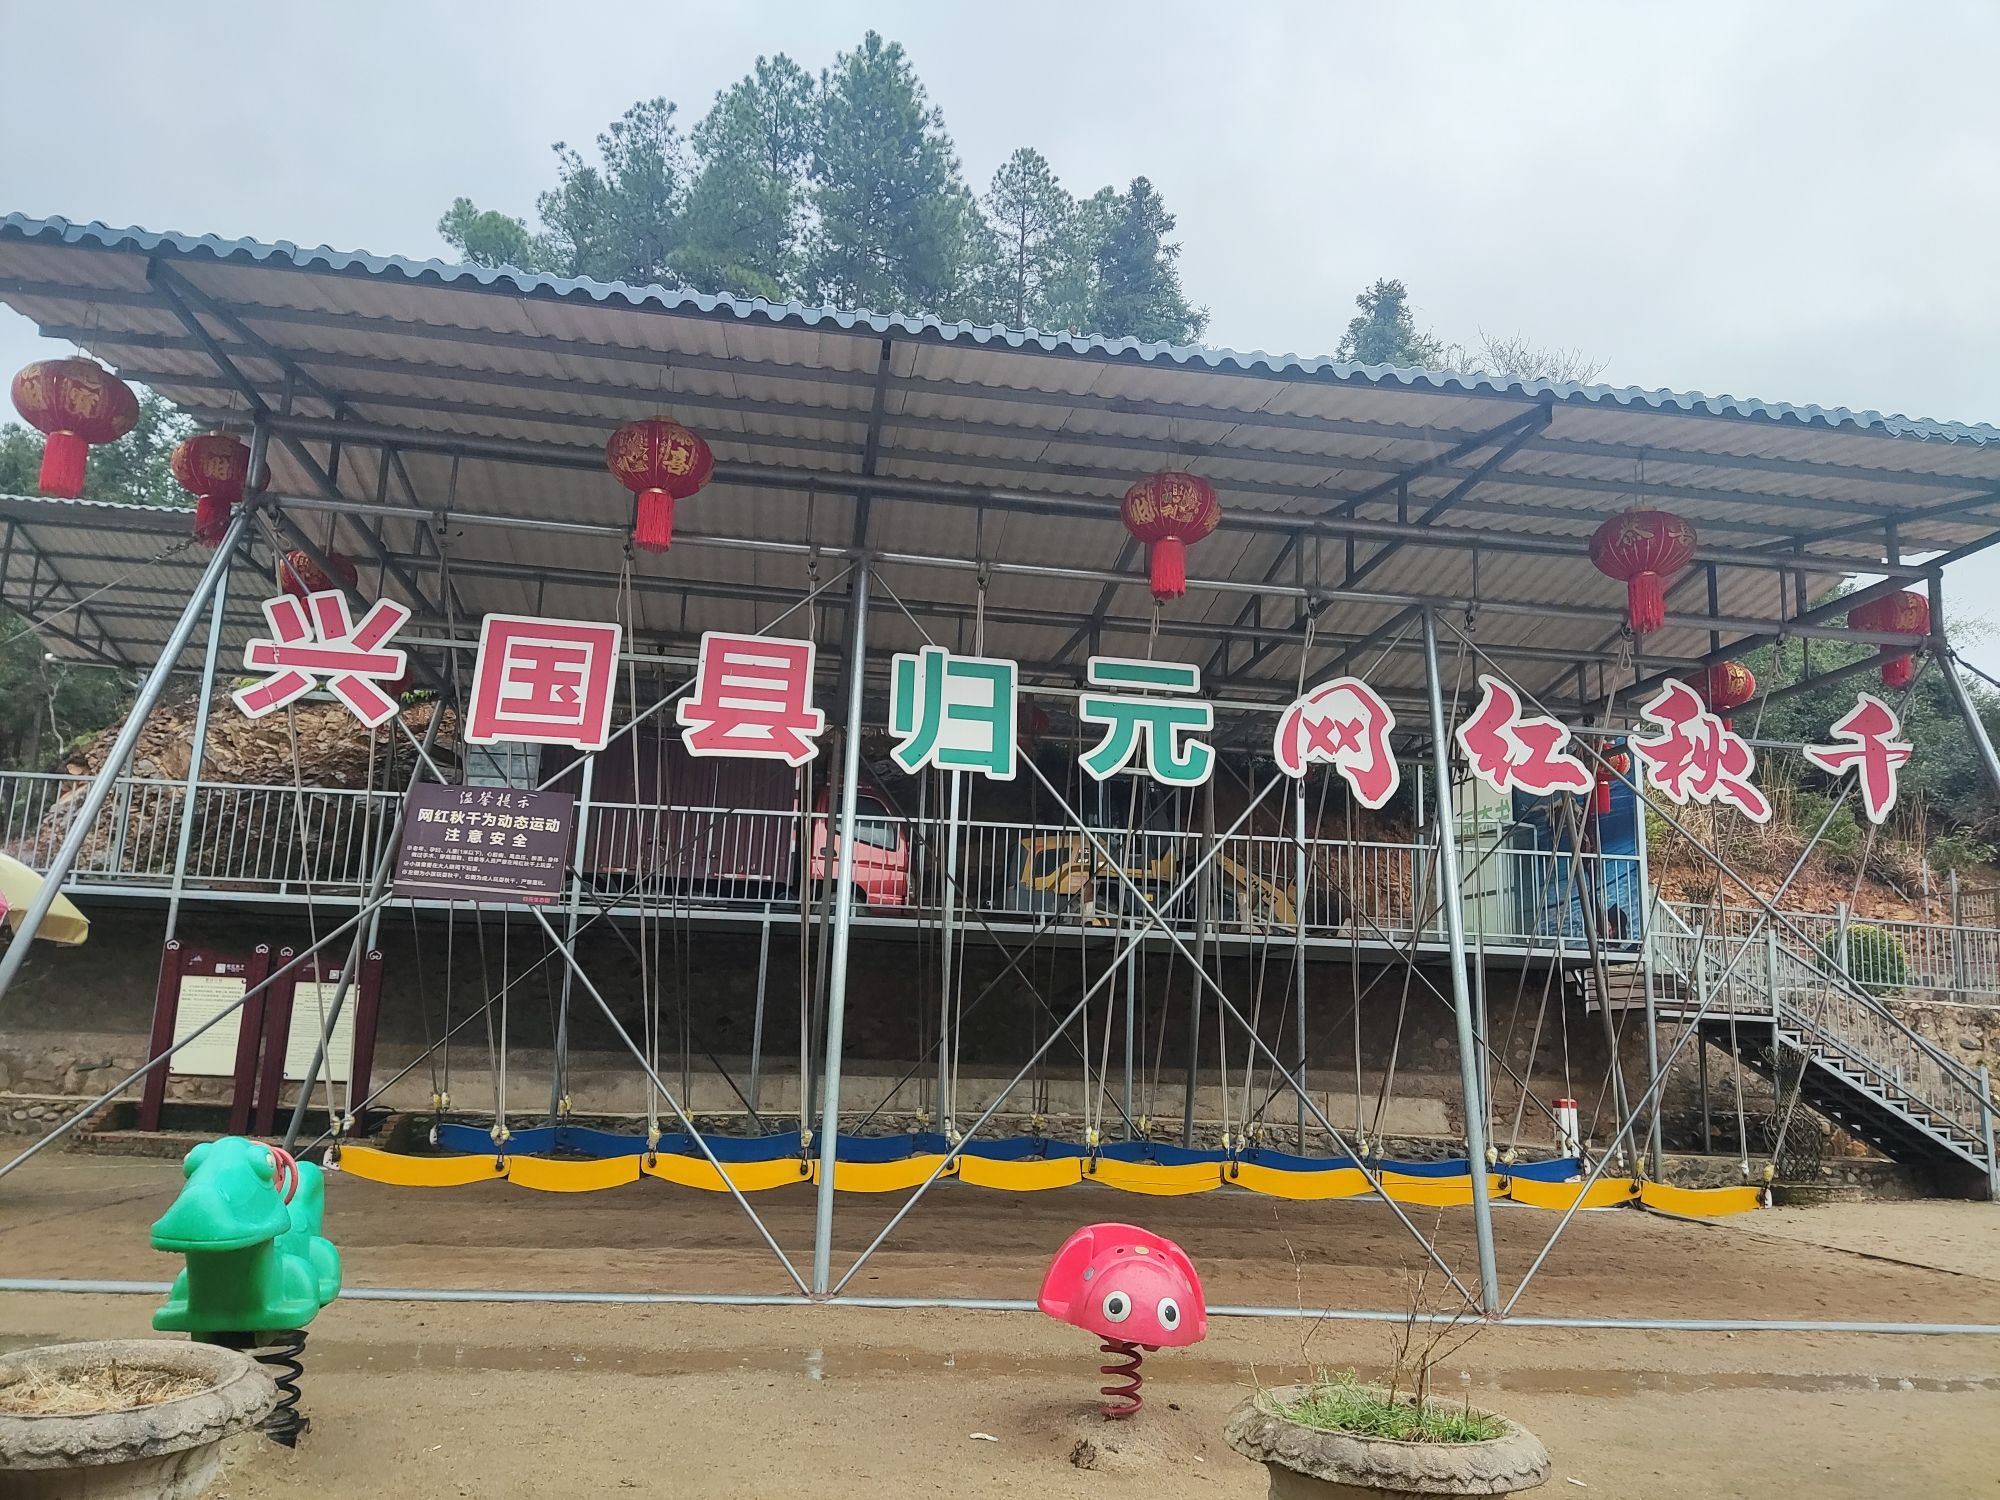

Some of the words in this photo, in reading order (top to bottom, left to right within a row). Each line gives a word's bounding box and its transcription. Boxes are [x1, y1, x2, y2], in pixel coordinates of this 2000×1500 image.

[232, 589, 1913, 826] 兴国县归元网红秋千
[459, 791, 530, 809] 温馨提示
[417, 808, 561, 833] 网红秋千为动态运动
[444, 828, 528, 848] 注意安全
